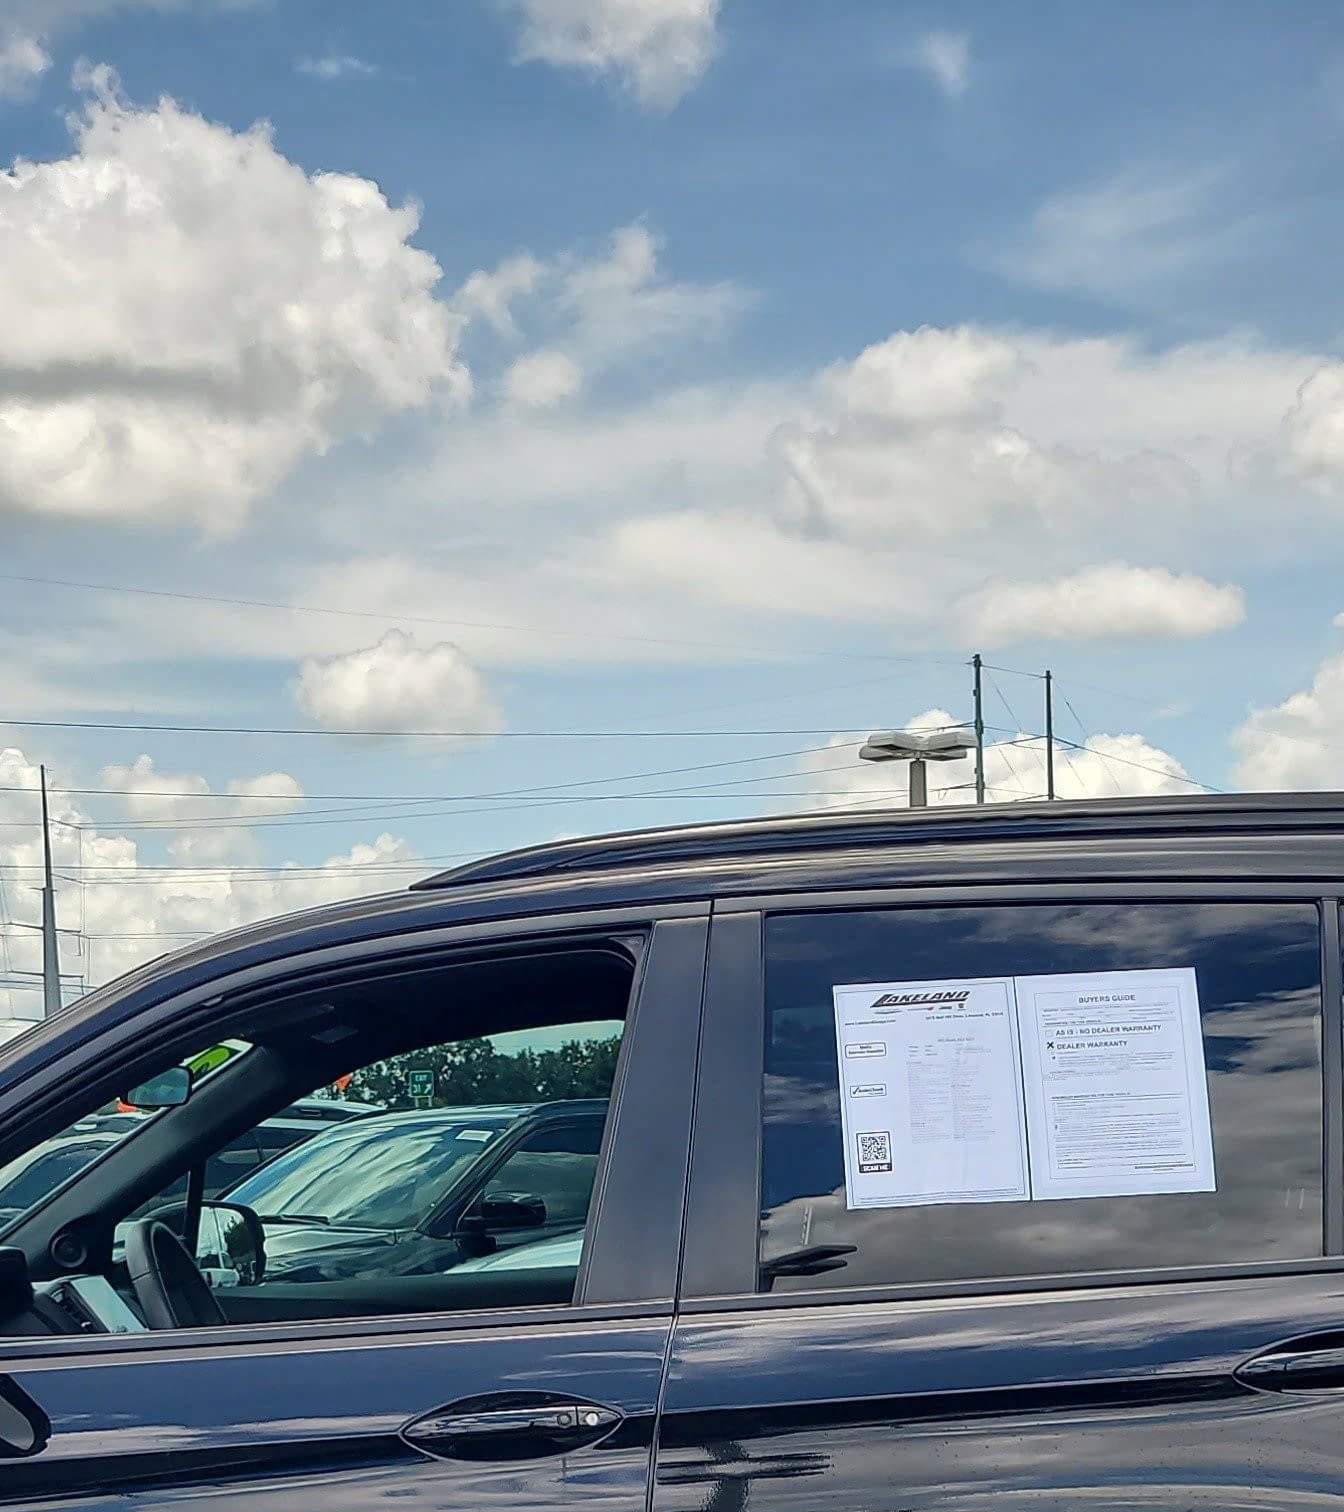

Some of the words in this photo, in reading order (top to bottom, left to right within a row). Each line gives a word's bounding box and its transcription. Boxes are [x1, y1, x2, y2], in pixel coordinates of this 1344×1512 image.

[870, 990, 971, 1008] LAKELAND
[1078, 995, 1110, 1004] BUYERS
[1112, 994, 1136, 1002] GUIDE
[1080, 1027, 1090, 1035] NO
[1092, 1026, 1120, 1034] DEALER
[1122, 1024, 1162, 1033] WARRANTY
[1056, 1042, 1085, 1050] DEALER
[1087, 1040, 1128, 1049] WARRANTY
